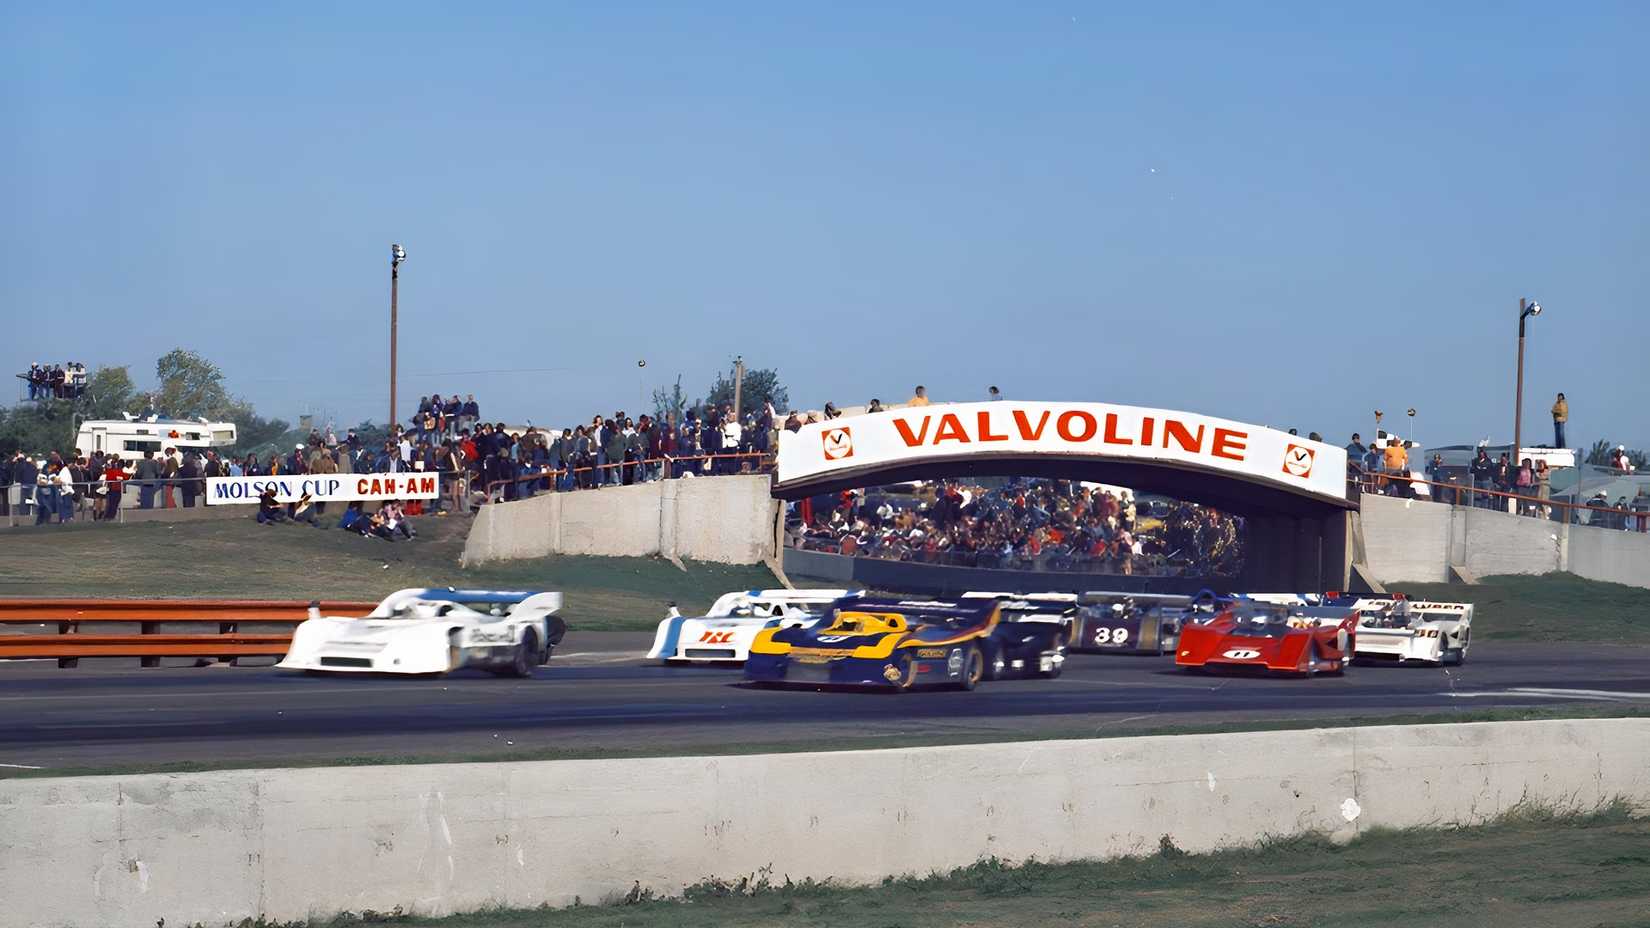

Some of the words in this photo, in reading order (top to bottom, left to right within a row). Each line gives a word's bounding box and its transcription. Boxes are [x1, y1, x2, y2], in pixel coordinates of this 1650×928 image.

[893, 409, 1248, 461] VALVOLINE
[214, 481, 292, 498] MOLSON
[302, 480, 340, 498] CUP
[357, 478, 435, 495] CAN-AM
